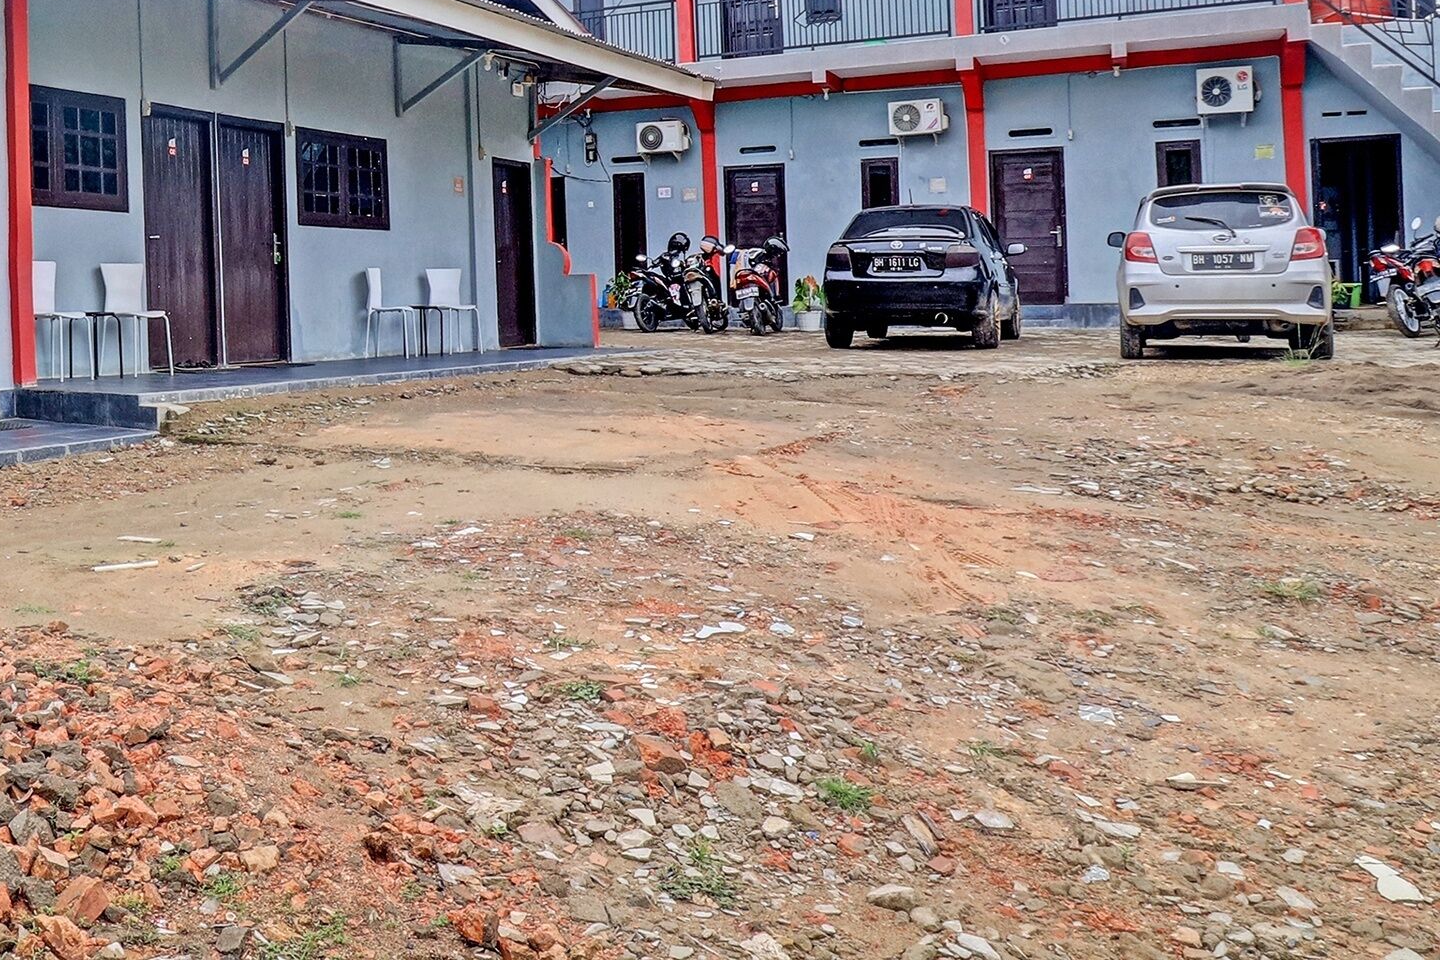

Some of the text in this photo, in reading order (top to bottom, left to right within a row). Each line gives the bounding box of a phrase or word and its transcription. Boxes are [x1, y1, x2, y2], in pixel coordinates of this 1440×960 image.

[1237, 83, 1248, 91] LG
[874, 258, 919, 267] BH 1611 LG
[1193, 254, 1205, 265] BH
[1213, 254, 1234, 264] 1057
